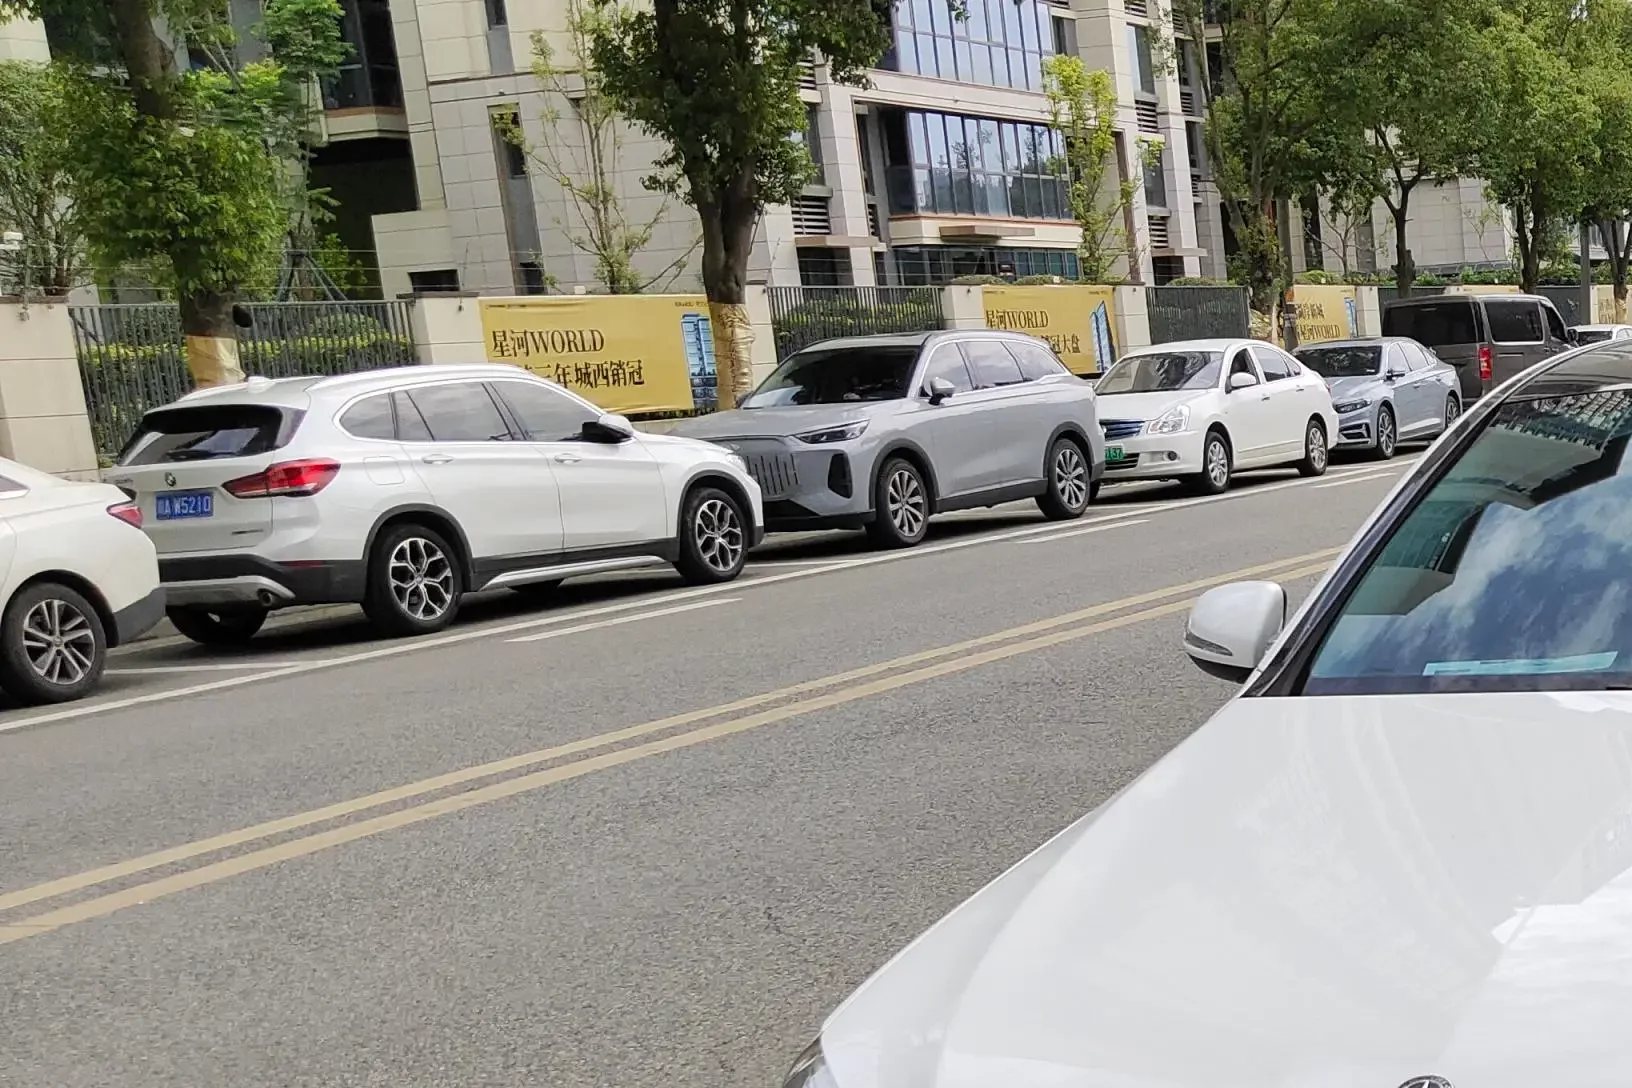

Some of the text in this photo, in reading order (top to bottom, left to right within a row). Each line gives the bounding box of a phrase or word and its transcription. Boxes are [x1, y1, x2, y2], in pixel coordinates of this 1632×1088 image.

[985, 309, 1049, 329] 星河WORLD
[492, 329, 605, 357] 星河WORLD
[523, 359, 645, 389] 三年城西销冠
